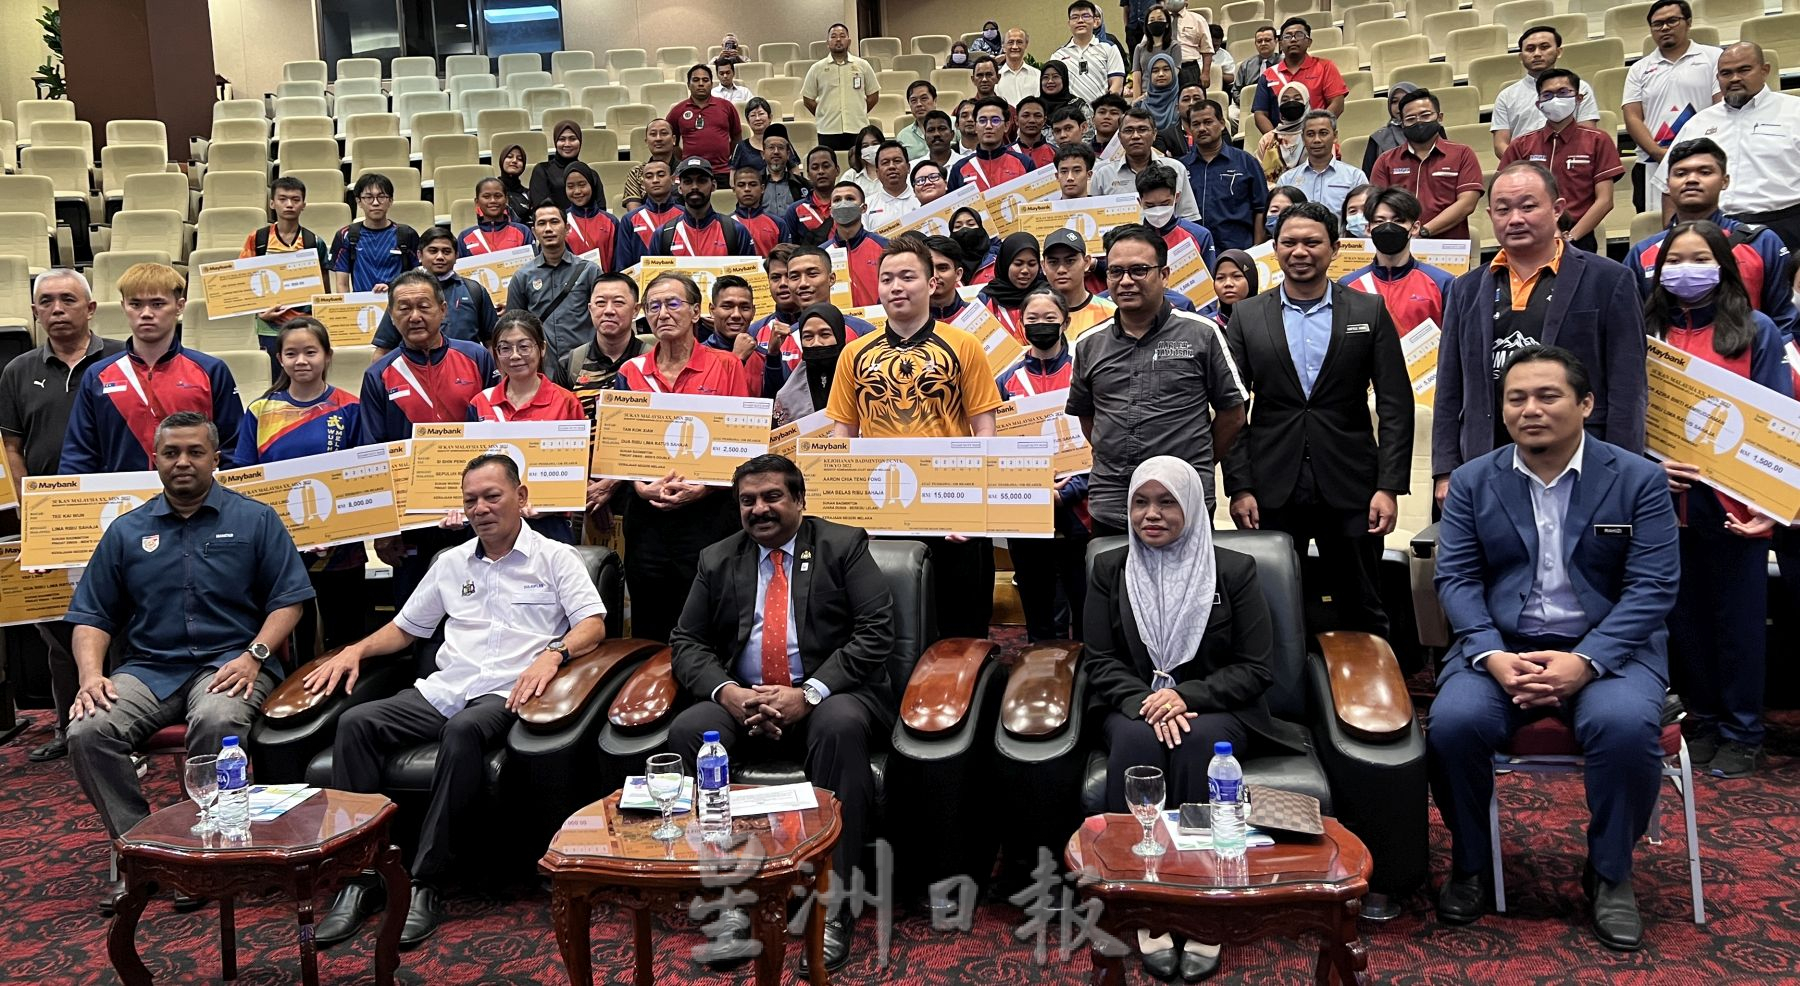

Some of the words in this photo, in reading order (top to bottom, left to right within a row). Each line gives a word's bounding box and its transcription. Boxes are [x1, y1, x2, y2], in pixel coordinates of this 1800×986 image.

[732, 264, 757, 273] Maybank
[1648, 344, 1686, 367] Maybank
[614, 394, 648, 404] Maybank
[427, 427, 462, 436] Maybank
[770, 427, 797, 443] Maybank
[723, 445, 748, 454] 2,500.00
[811, 442, 848, 452] Maybank
[1753, 454, 1784, 474] 1,500.00
[227, 470, 262, 482] Maybank
[540, 470, 569, 478] 10,000.00
[38, 481, 77, 490] Maybank
[934, 491, 965, 499] 15,000.00
[1000, 492, 1032, 500] 55,000.00
[348, 498, 373, 508] 8,000.00
